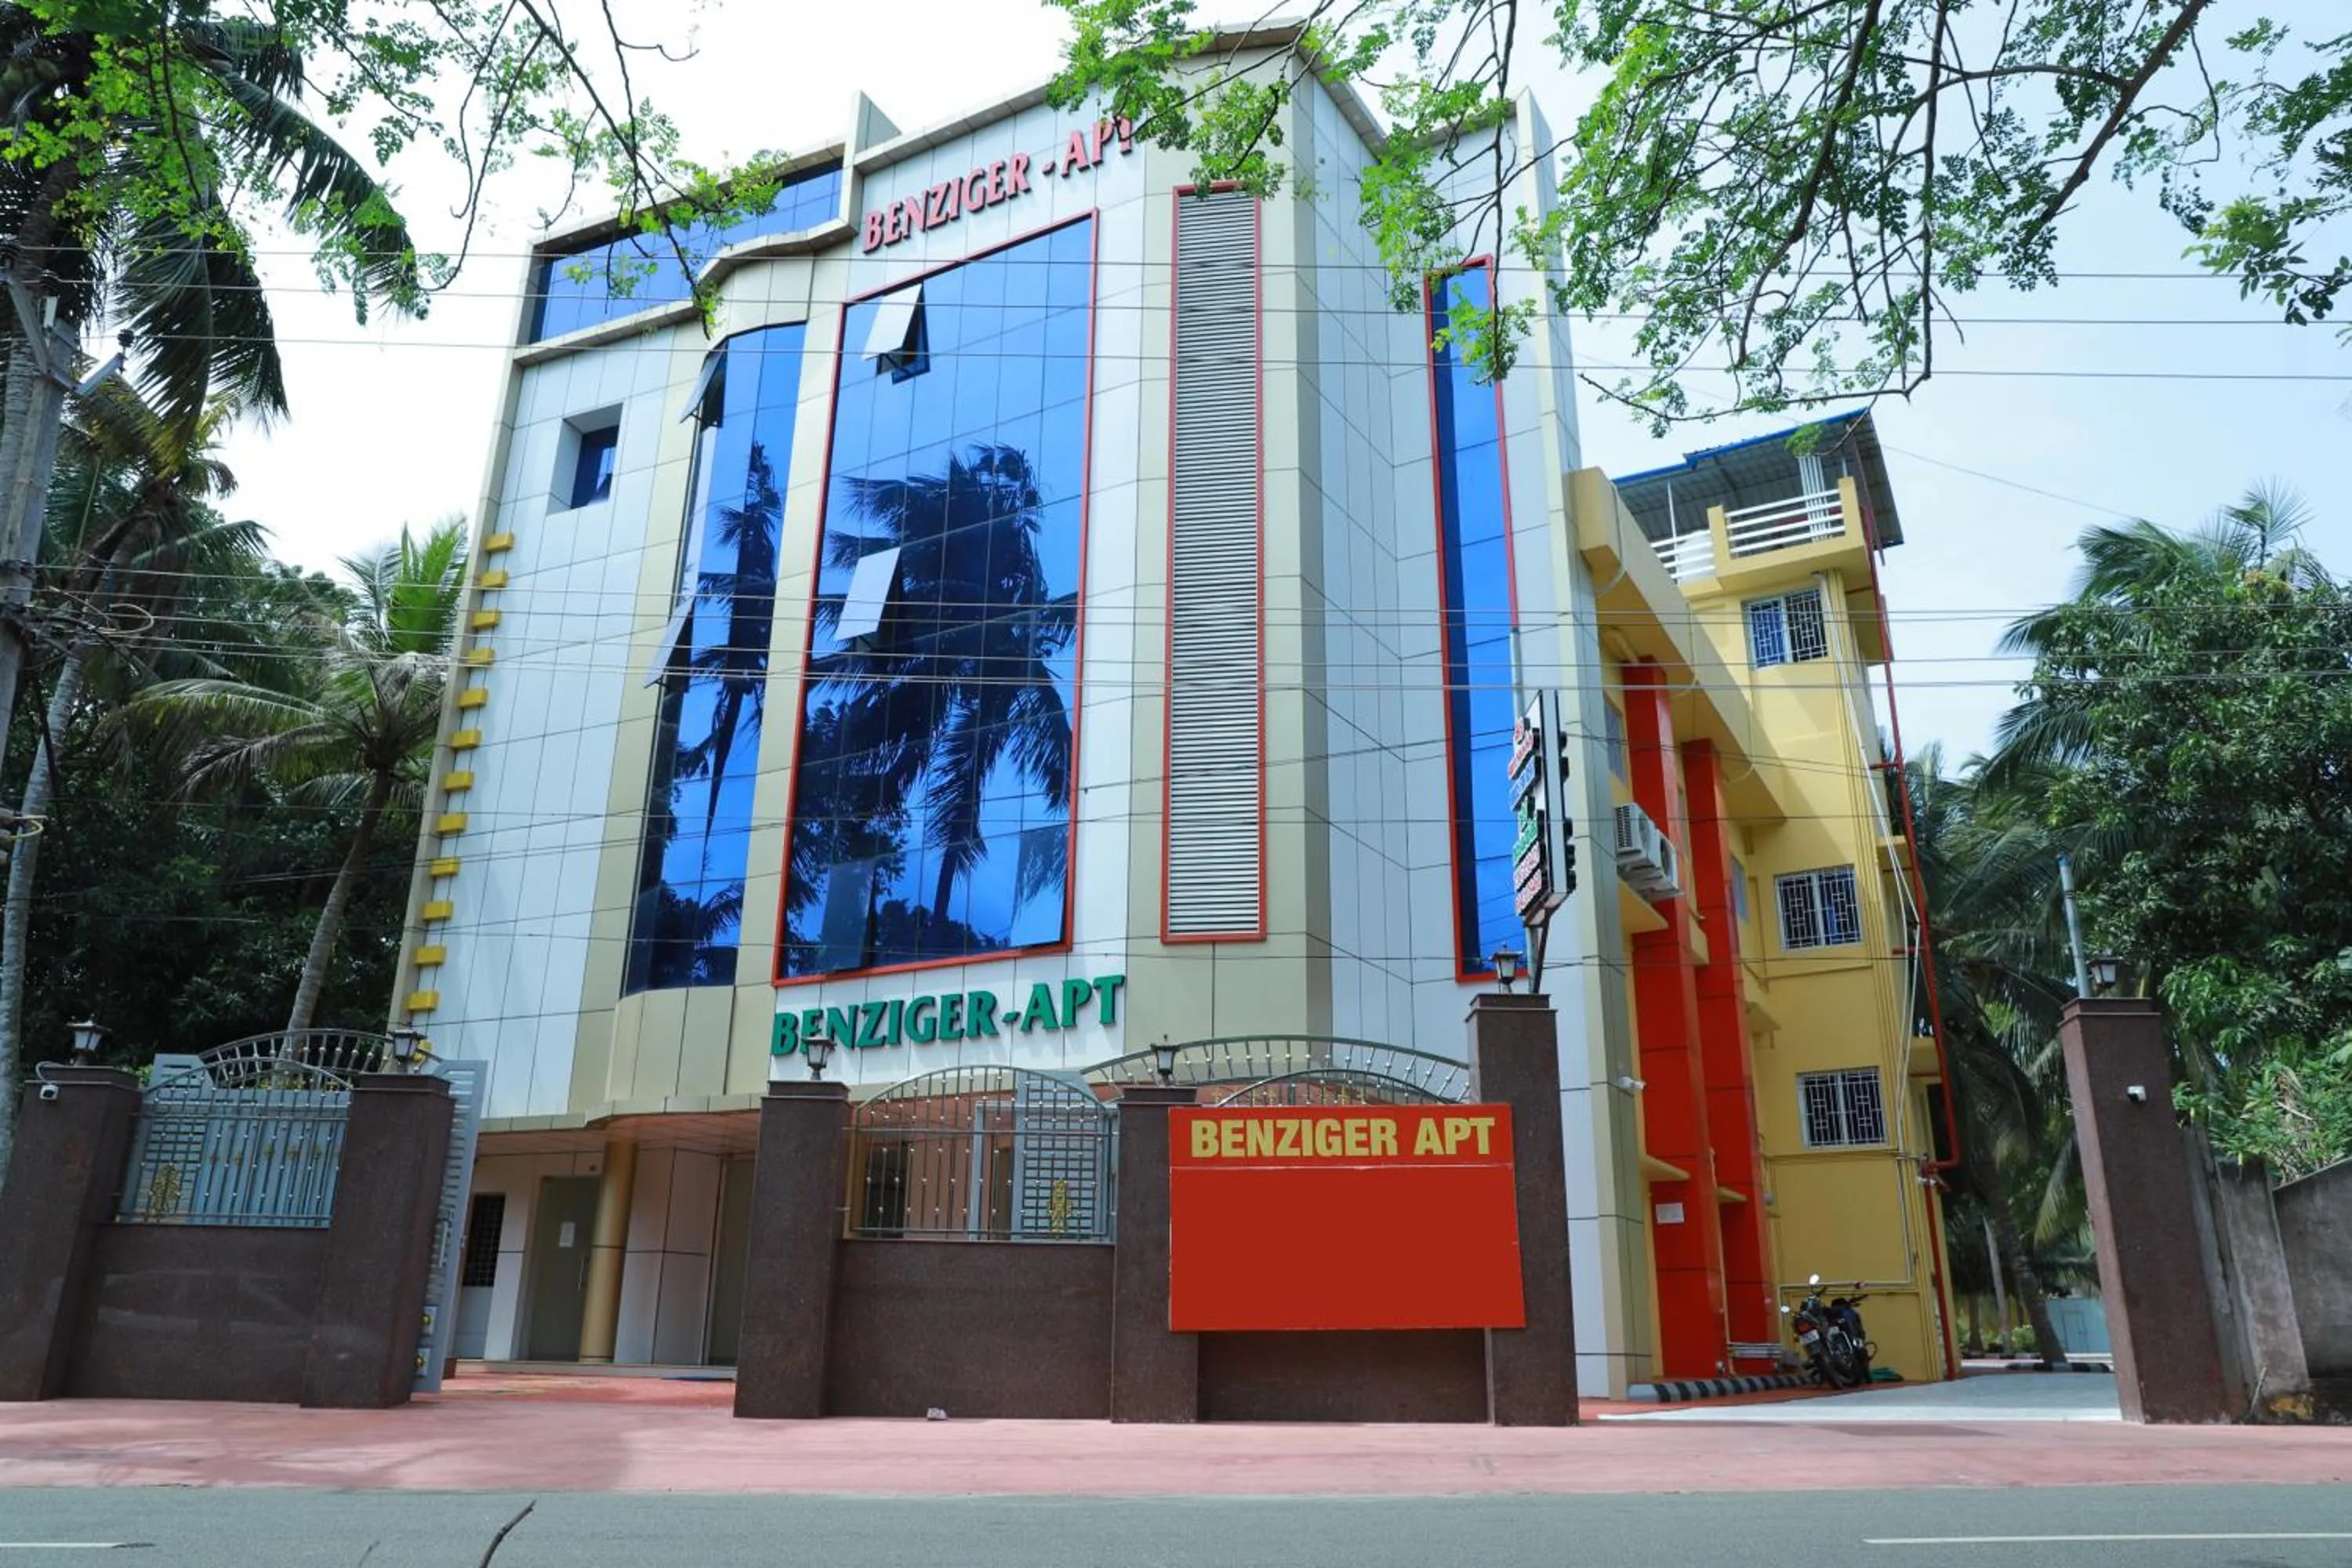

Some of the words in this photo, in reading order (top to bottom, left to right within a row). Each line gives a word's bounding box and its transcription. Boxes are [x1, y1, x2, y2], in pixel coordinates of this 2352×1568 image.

[864, 153, 1031, 253] BENZIGER
[1191, 1118, 1399, 1158] BENZIGER
[1414, 1117, 1495, 1156] APT
